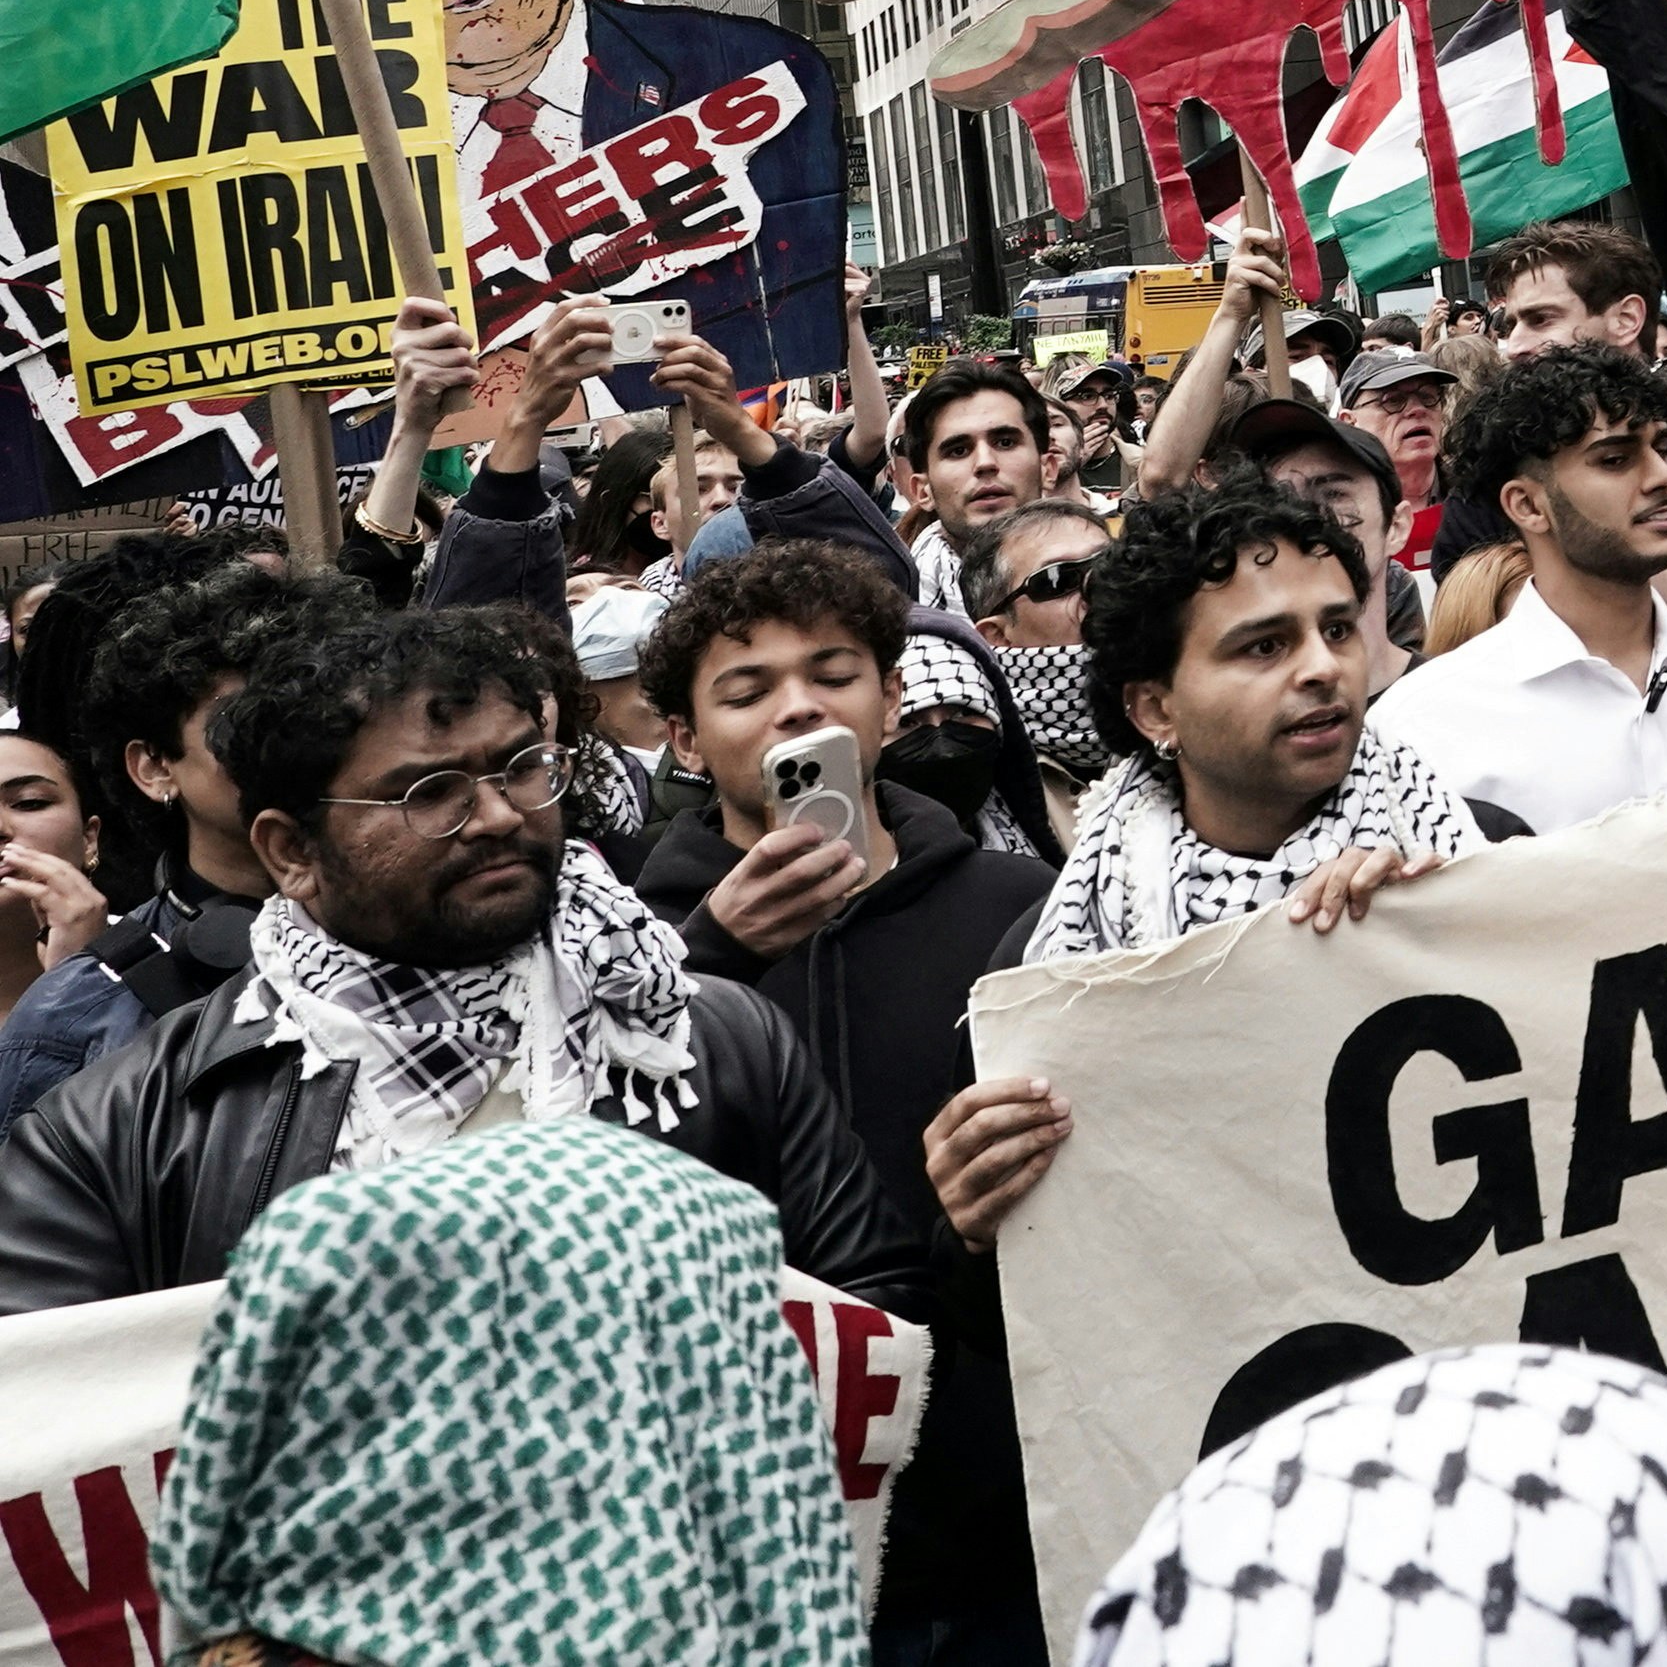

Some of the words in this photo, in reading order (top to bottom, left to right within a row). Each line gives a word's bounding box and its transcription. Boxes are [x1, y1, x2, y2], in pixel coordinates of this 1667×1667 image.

[66, 49, 428, 174] WAR
[74, 187, 206, 342] ON
[916, 348, 944, 360] FREE
[22, 530, 108, 565] FREE
